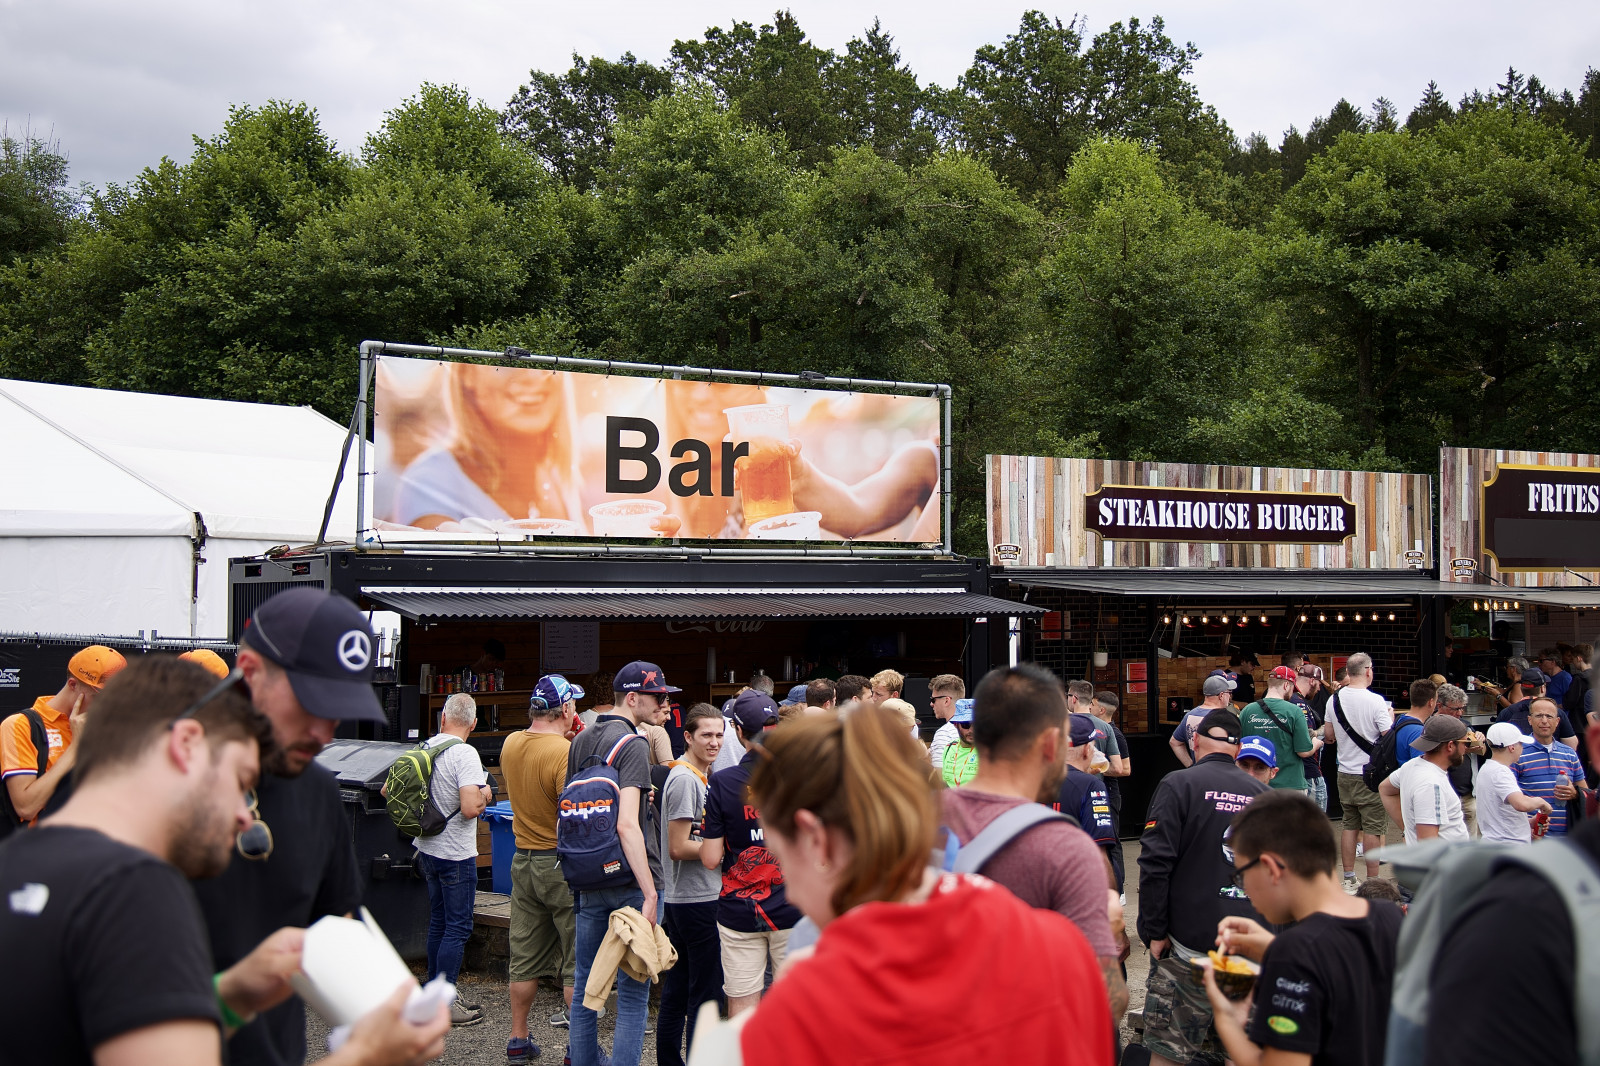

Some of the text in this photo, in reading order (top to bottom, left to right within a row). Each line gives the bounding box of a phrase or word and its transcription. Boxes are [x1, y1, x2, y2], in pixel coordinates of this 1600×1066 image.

[606, 415, 749, 497] Bar
[1528, 483, 1599, 513] FRITES
[1098, 497, 1346, 532] STEAKHOUSE BURGER
[1247, 713, 1270, 726] Tommy
[560, 798, 614, 819] Super
